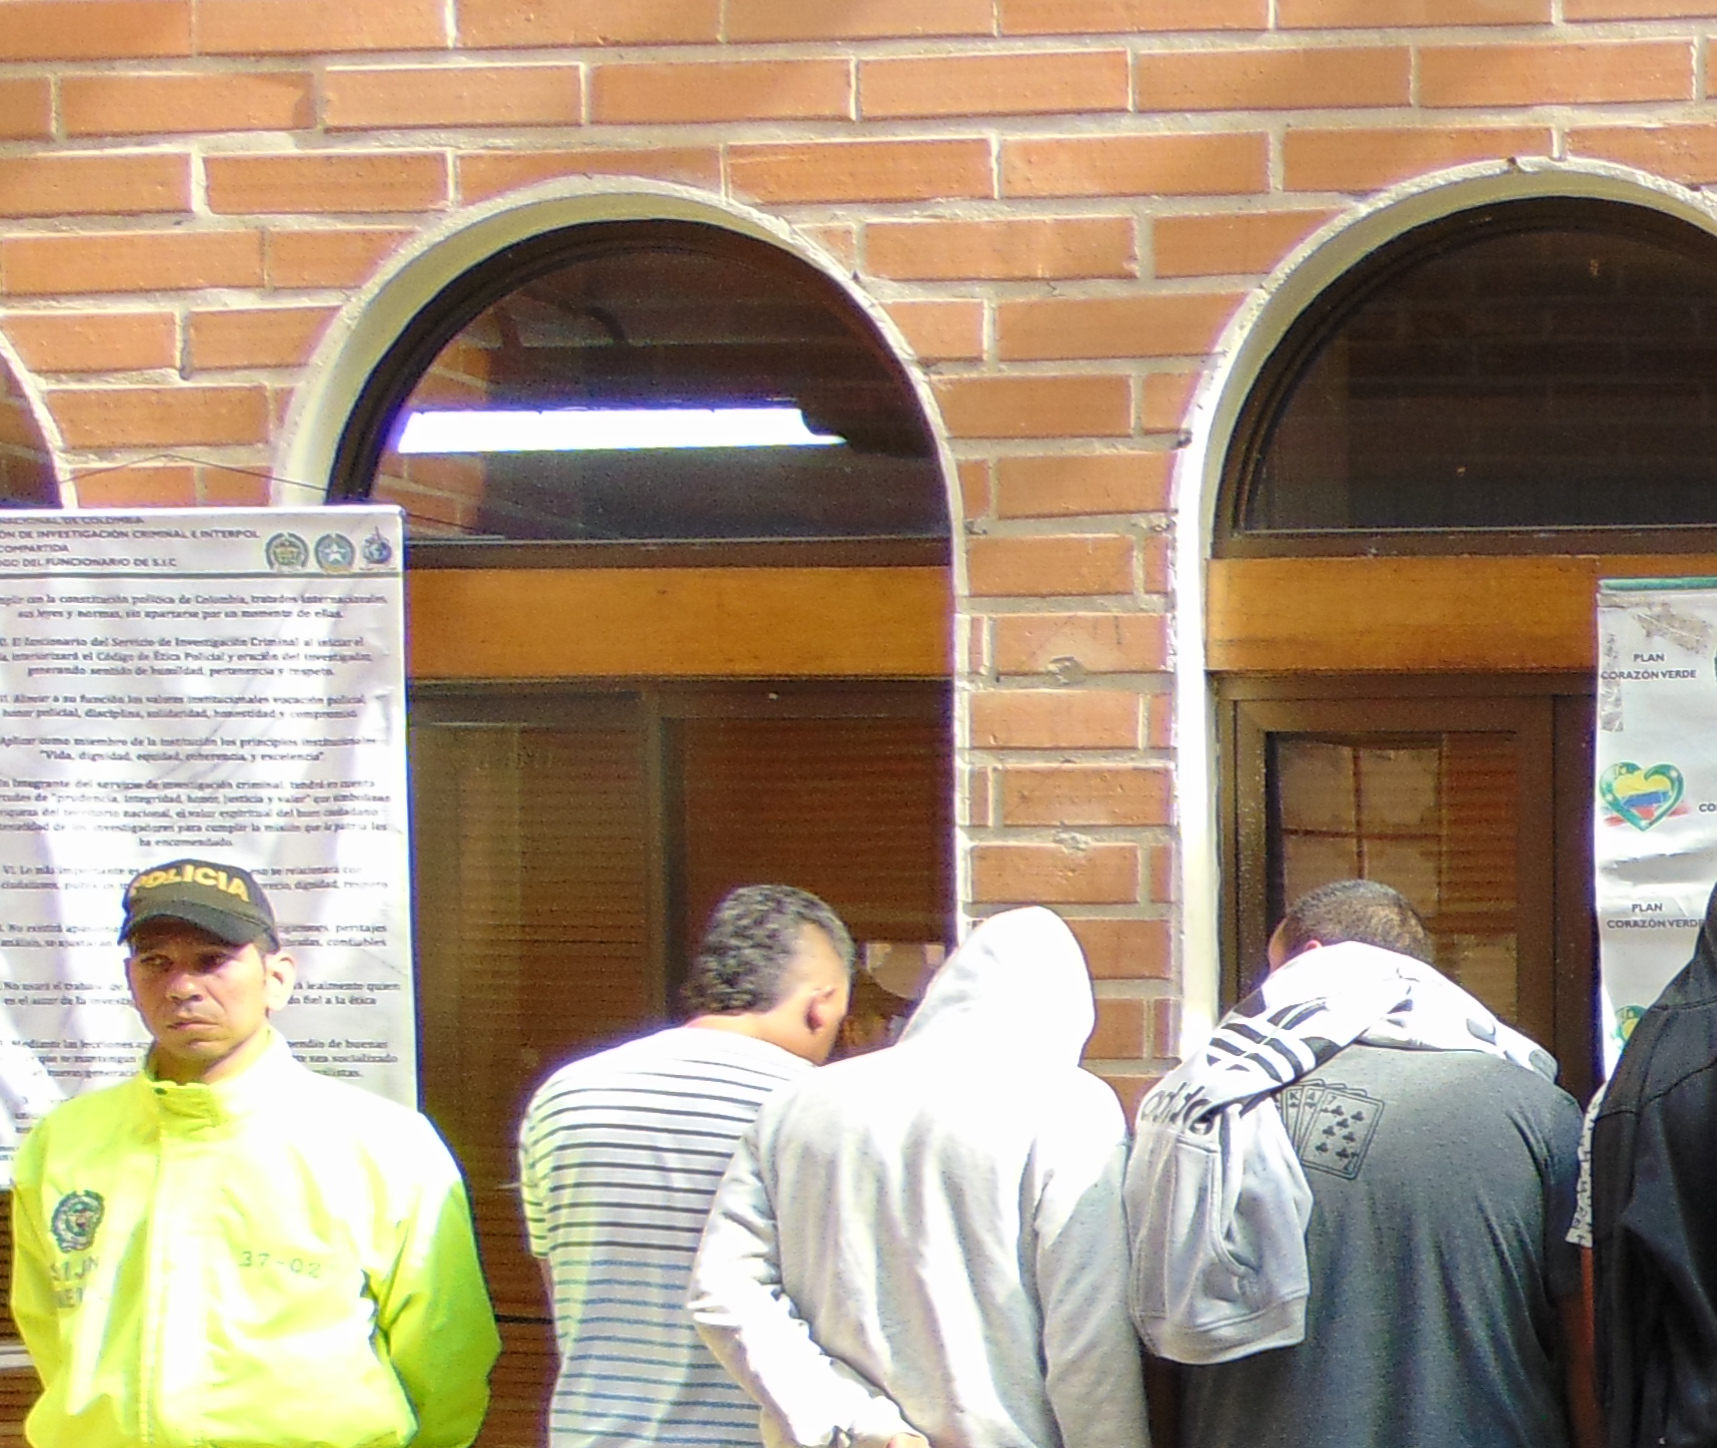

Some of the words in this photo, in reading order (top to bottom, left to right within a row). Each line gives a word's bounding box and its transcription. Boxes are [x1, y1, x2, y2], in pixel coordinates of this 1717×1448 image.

[201, 529, 260, 539] INTERPOL
[1633, 653, 1665, 663] PLAN
[1599, 663, 1660, 681] CORAZÓN
[1659, 669, 1697, 680] VERDE
[1631, 903, 1663, 913] PLAN
[1606, 914, 1668, 929] CORAZÓN
